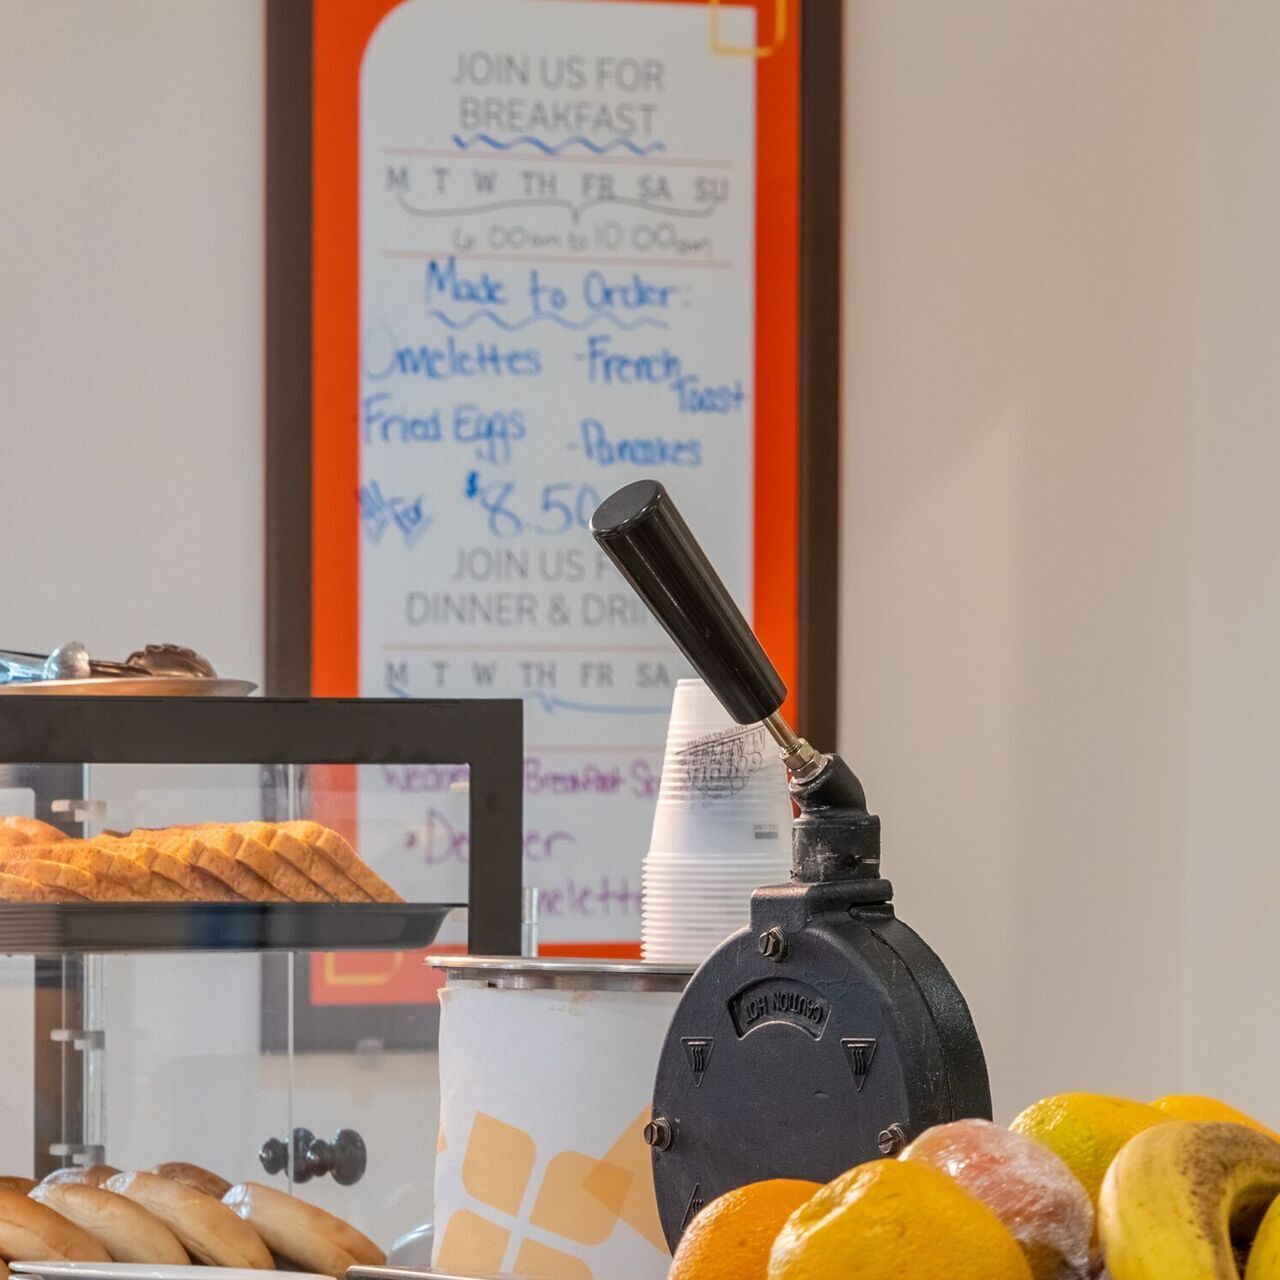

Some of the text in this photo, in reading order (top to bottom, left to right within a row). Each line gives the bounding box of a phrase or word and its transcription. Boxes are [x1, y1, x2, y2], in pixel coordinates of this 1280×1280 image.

[451, 51, 666, 93] JOIN US FOR
[458, 96, 658, 136] BREAKFAST
[386, 166, 410, 191] M
[434, 167, 449, 193] T
[473, 169, 498, 194] W
[521, 171, 557, 198] TH
[637, 175, 673, 201] SA
[695, 177, 730, 204] SU
[426, 257, 506, 306] Made
[529, 268, 567, 312] to
[362, 393, 526, 464] Fried Eggs
[452, 547, 529, 583] JOIN
[542, 549, 586, 583] US
[406, 591, 537, 627] DINNER
[548, 593, 571, 625] &
[385, 661, 671, 688] M T W TH FR SA
[745, 993, 823, 1025] CAUTION HOT
